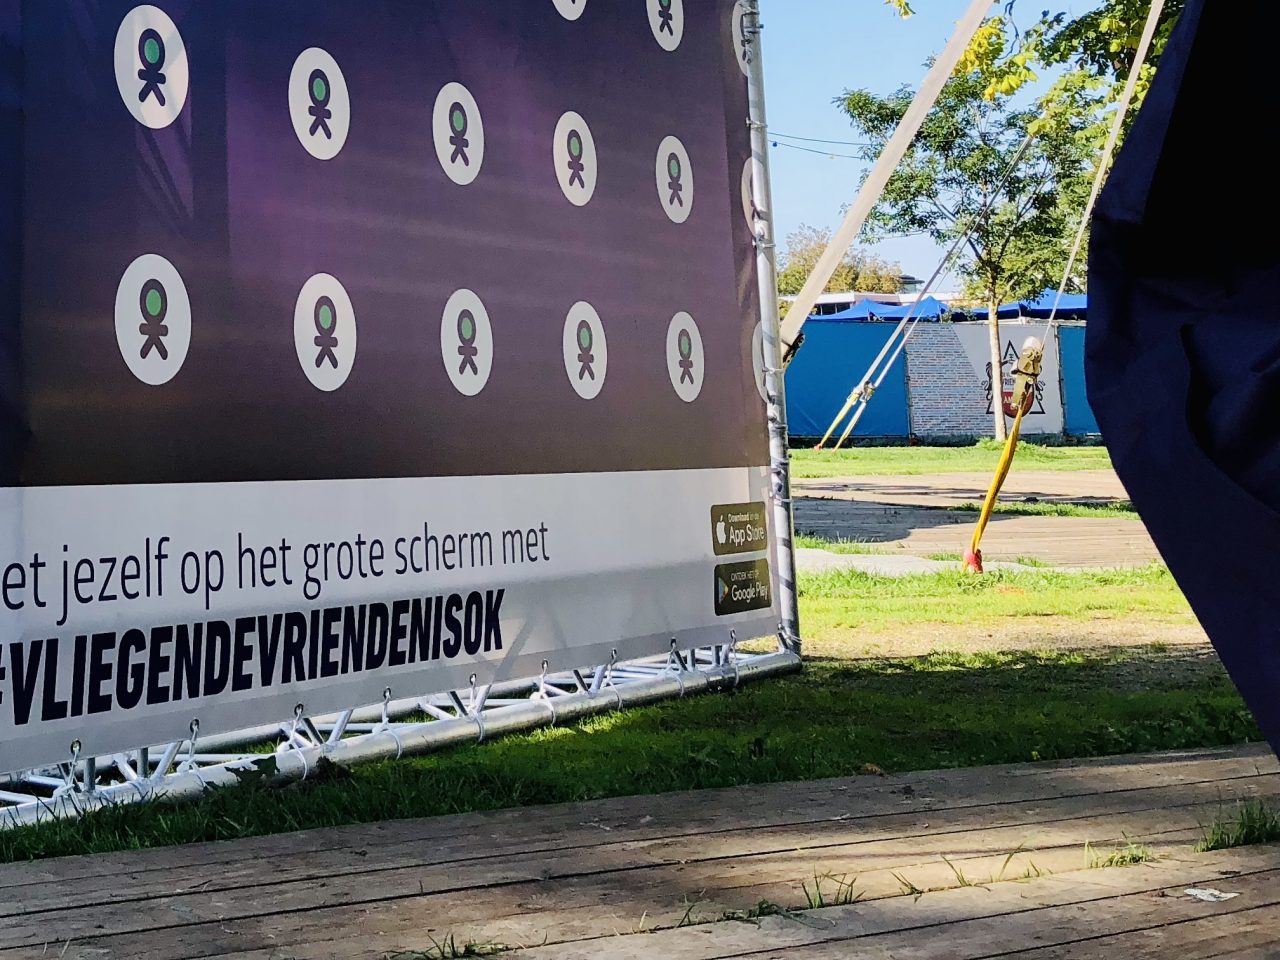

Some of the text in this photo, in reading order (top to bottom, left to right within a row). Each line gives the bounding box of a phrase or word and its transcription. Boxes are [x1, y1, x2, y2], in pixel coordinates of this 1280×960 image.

[729, 523, 765, 547] App Store
[56, 536, 170, 626] jezelf
[180, 549, 224, 610] op
[238, 532, 293, 589] het
[303, 533, 385, 600] grote
[394, 521, 493, 575] scherm
[502, 521, 550, 565] met
[731, 581, 768, 603] Google Play
